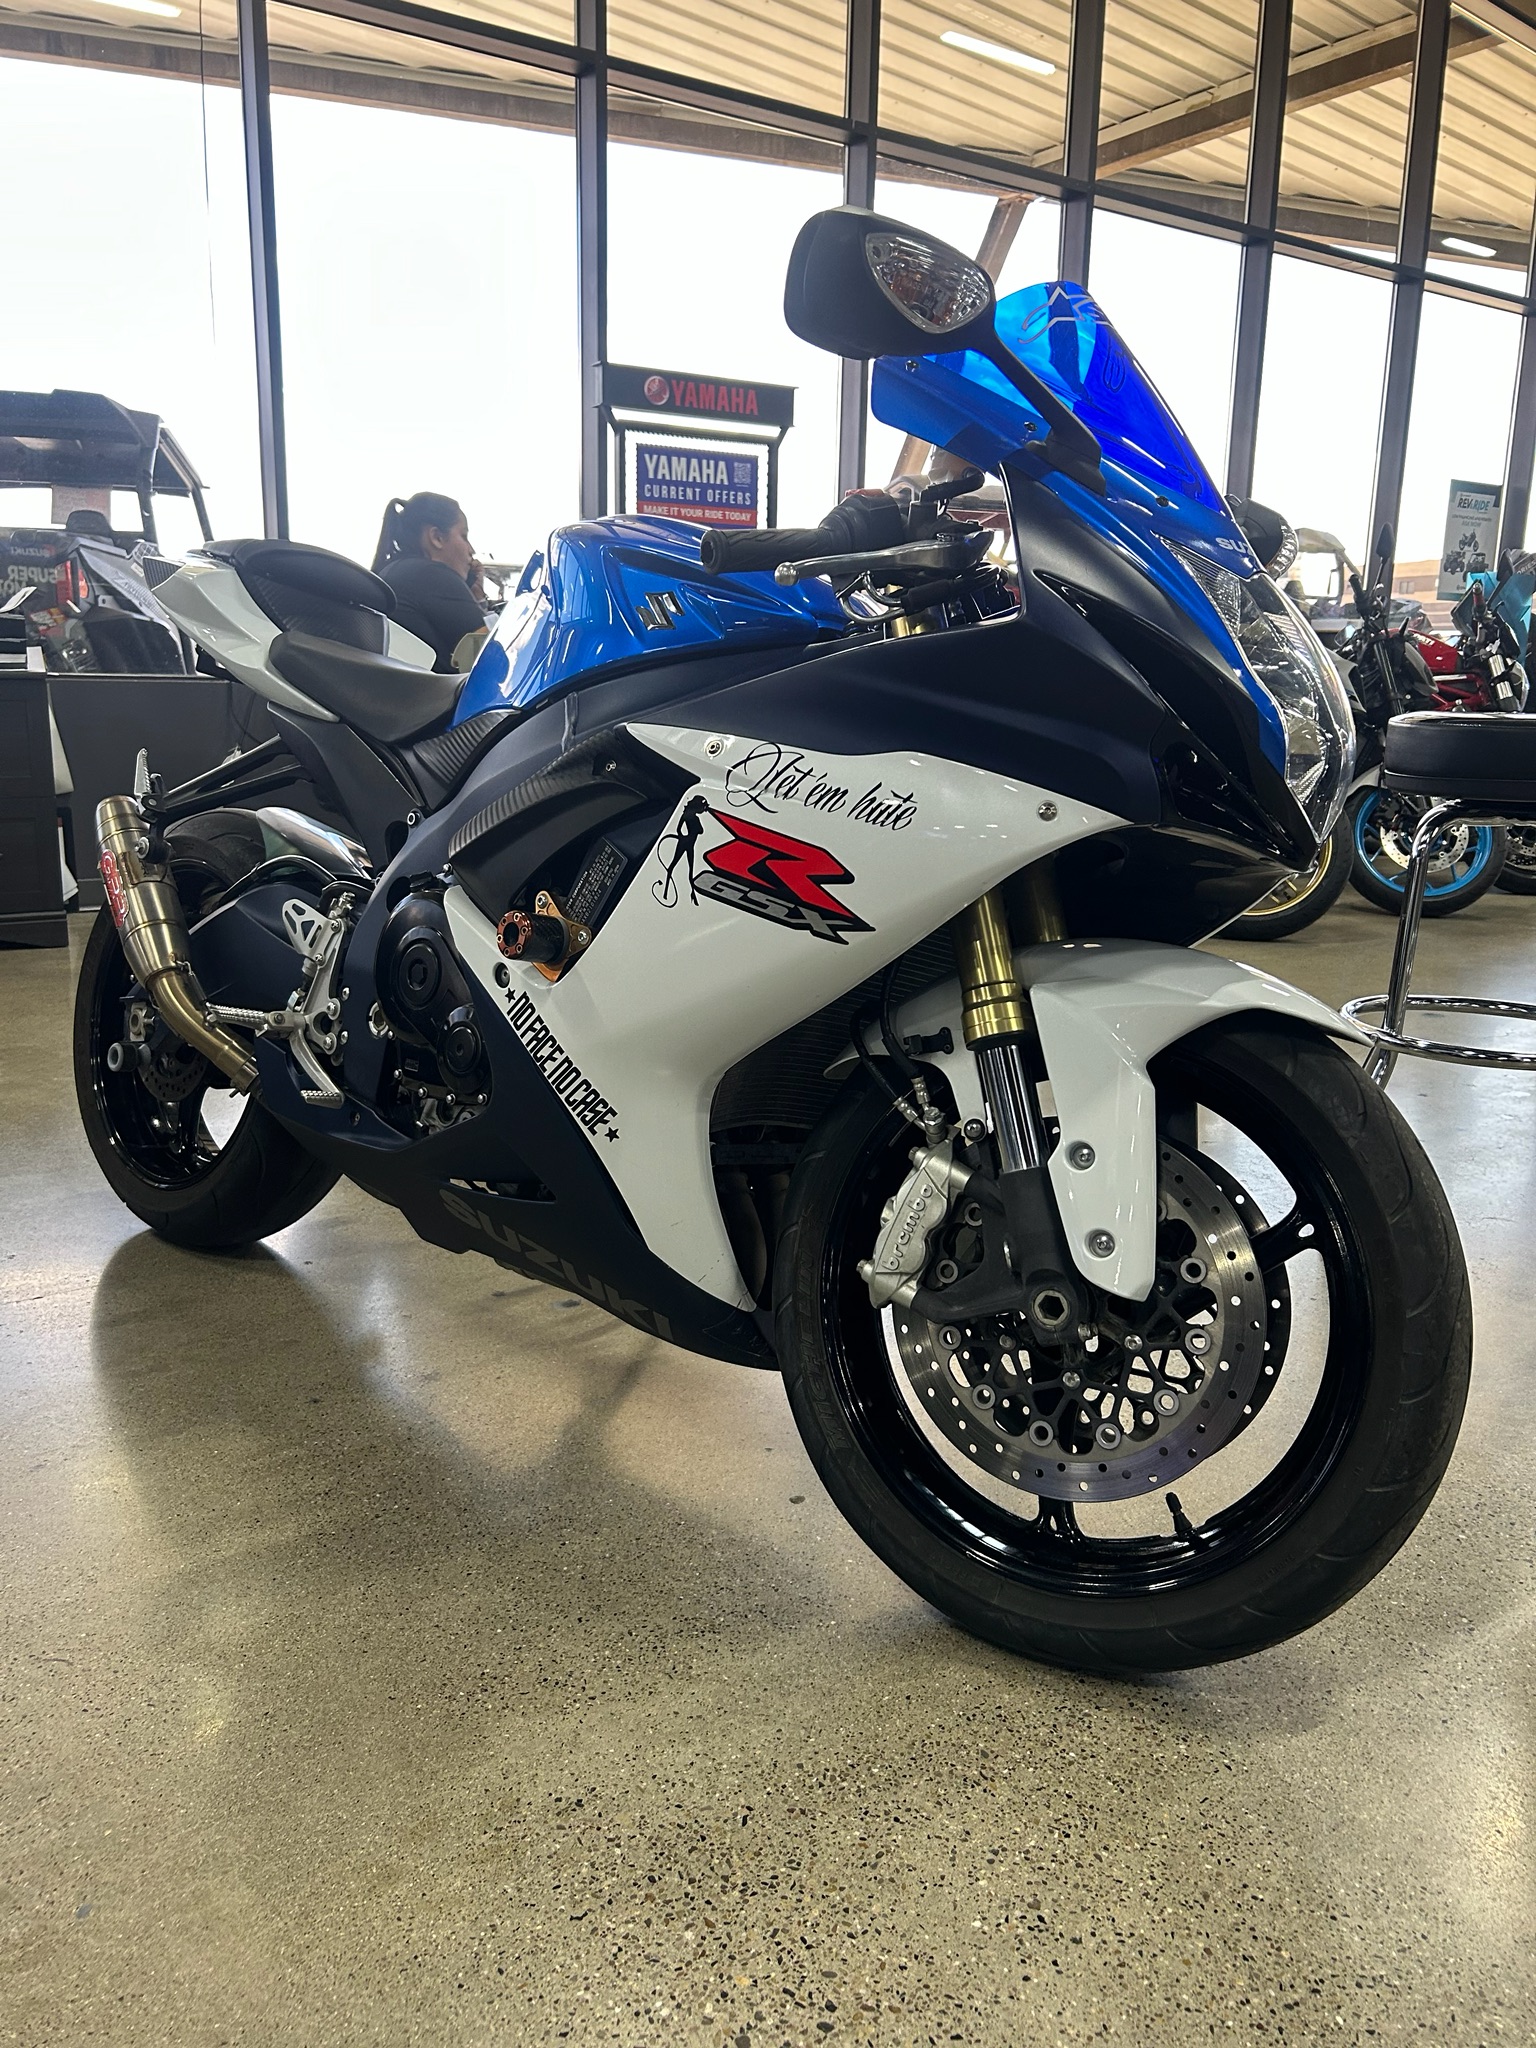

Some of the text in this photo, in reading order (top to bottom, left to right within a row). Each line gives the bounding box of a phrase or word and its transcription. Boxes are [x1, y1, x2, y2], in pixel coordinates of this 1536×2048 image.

[671, 379, 759, 416] YAMAHA
[644, 453, 729, 486] YAMAHA
[644, 484, 752, 505] CURRENT OFFERS
[643, 505, 752, 522] MAKE IT YOUR RIDE TODAY
[692, 870, 850, 945] GSX
[506, 991, 618, 1136] NO FACE NO CASE
[882, 1183, 934, 1271] brembo
[439, 1189, 674, 1341] SUZUKI
[798, 1251, 852, 1452] MICHELIN
